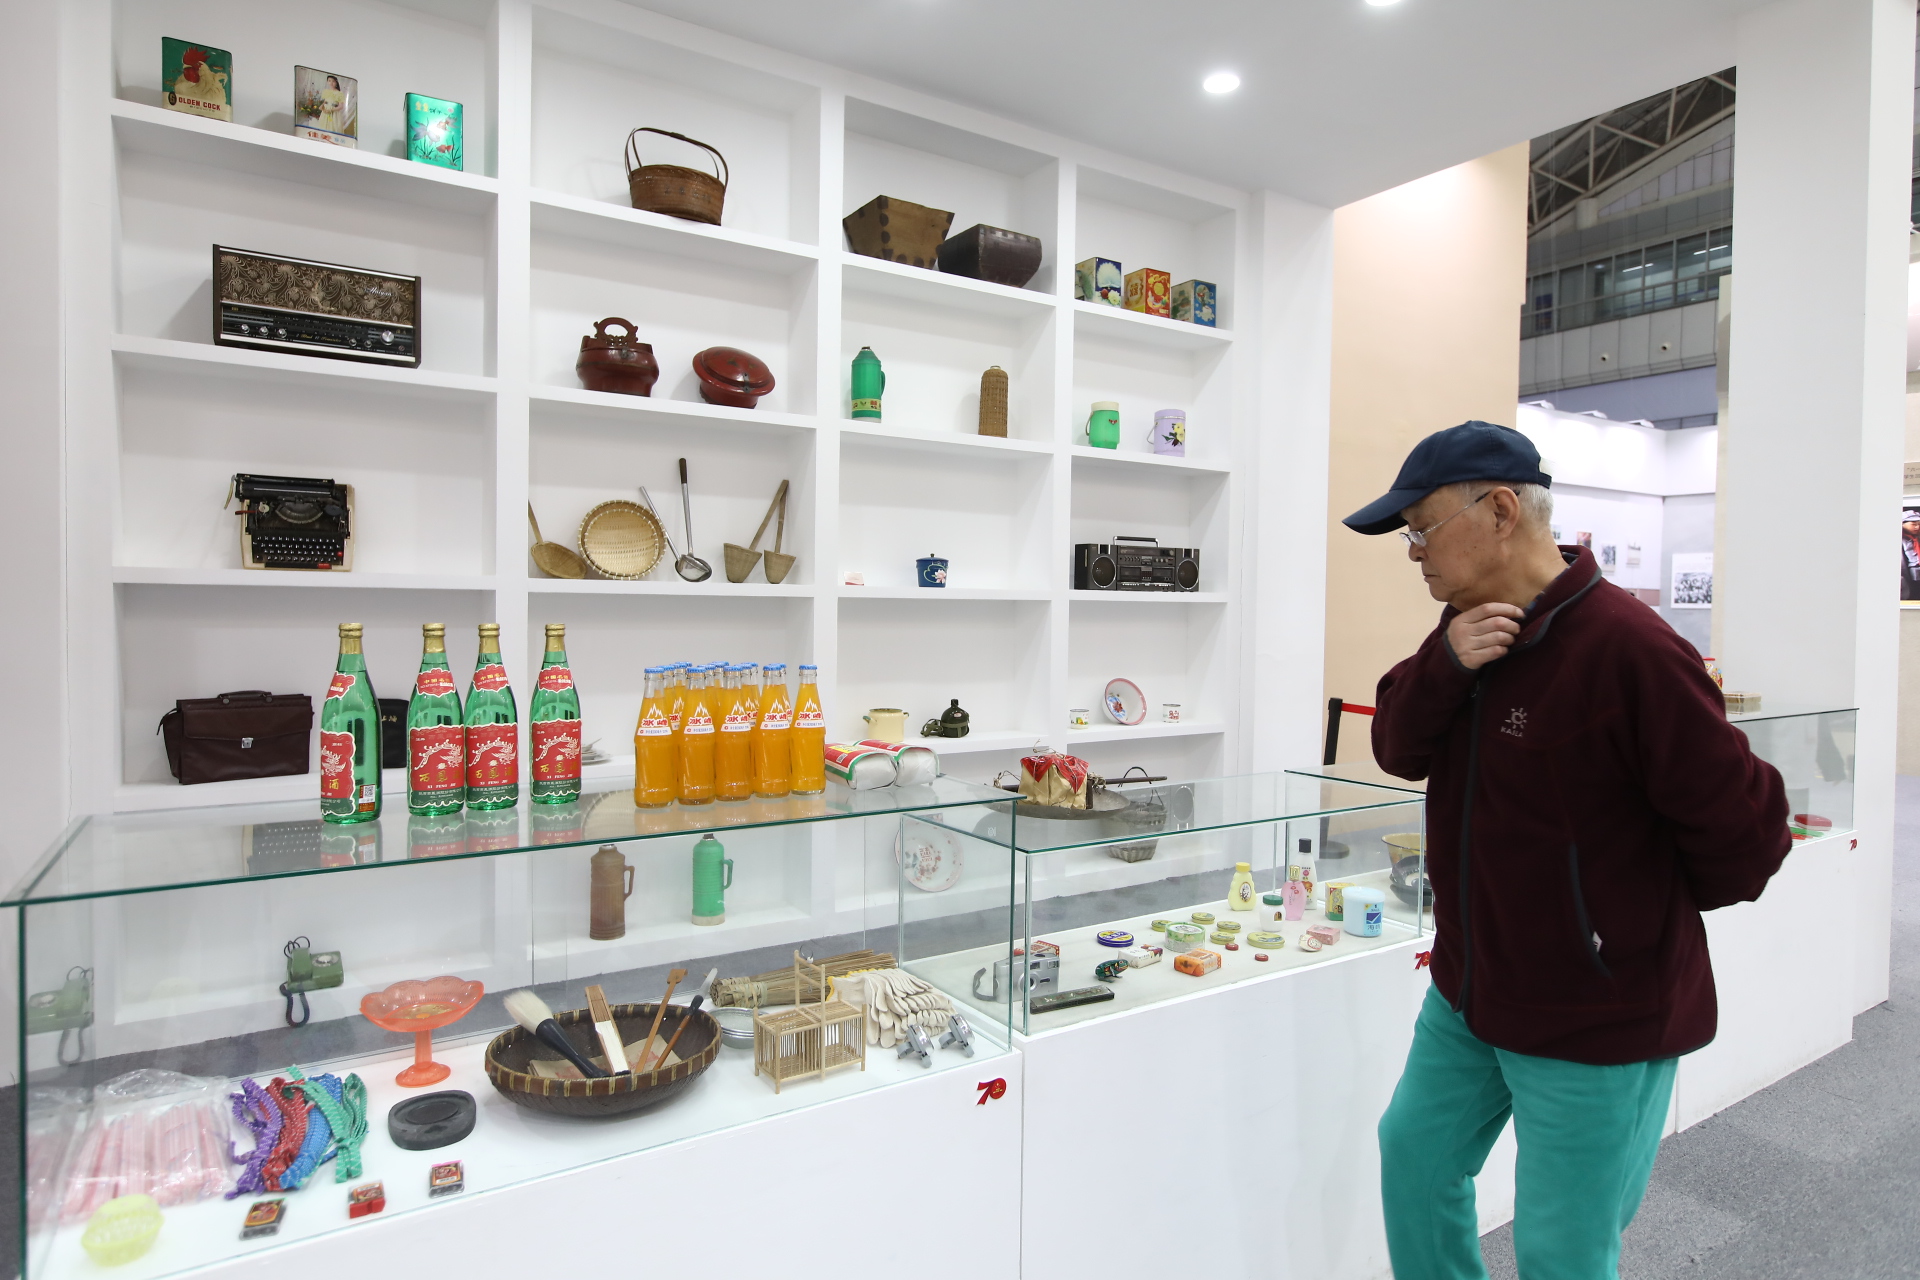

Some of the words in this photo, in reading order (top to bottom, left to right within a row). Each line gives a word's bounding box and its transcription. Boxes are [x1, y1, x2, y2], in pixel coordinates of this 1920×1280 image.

[169, 93, 200, 106] GOLDEN
[203, 102, 221, 110] COCK
[976, 1078, 1007, 1106] 70
